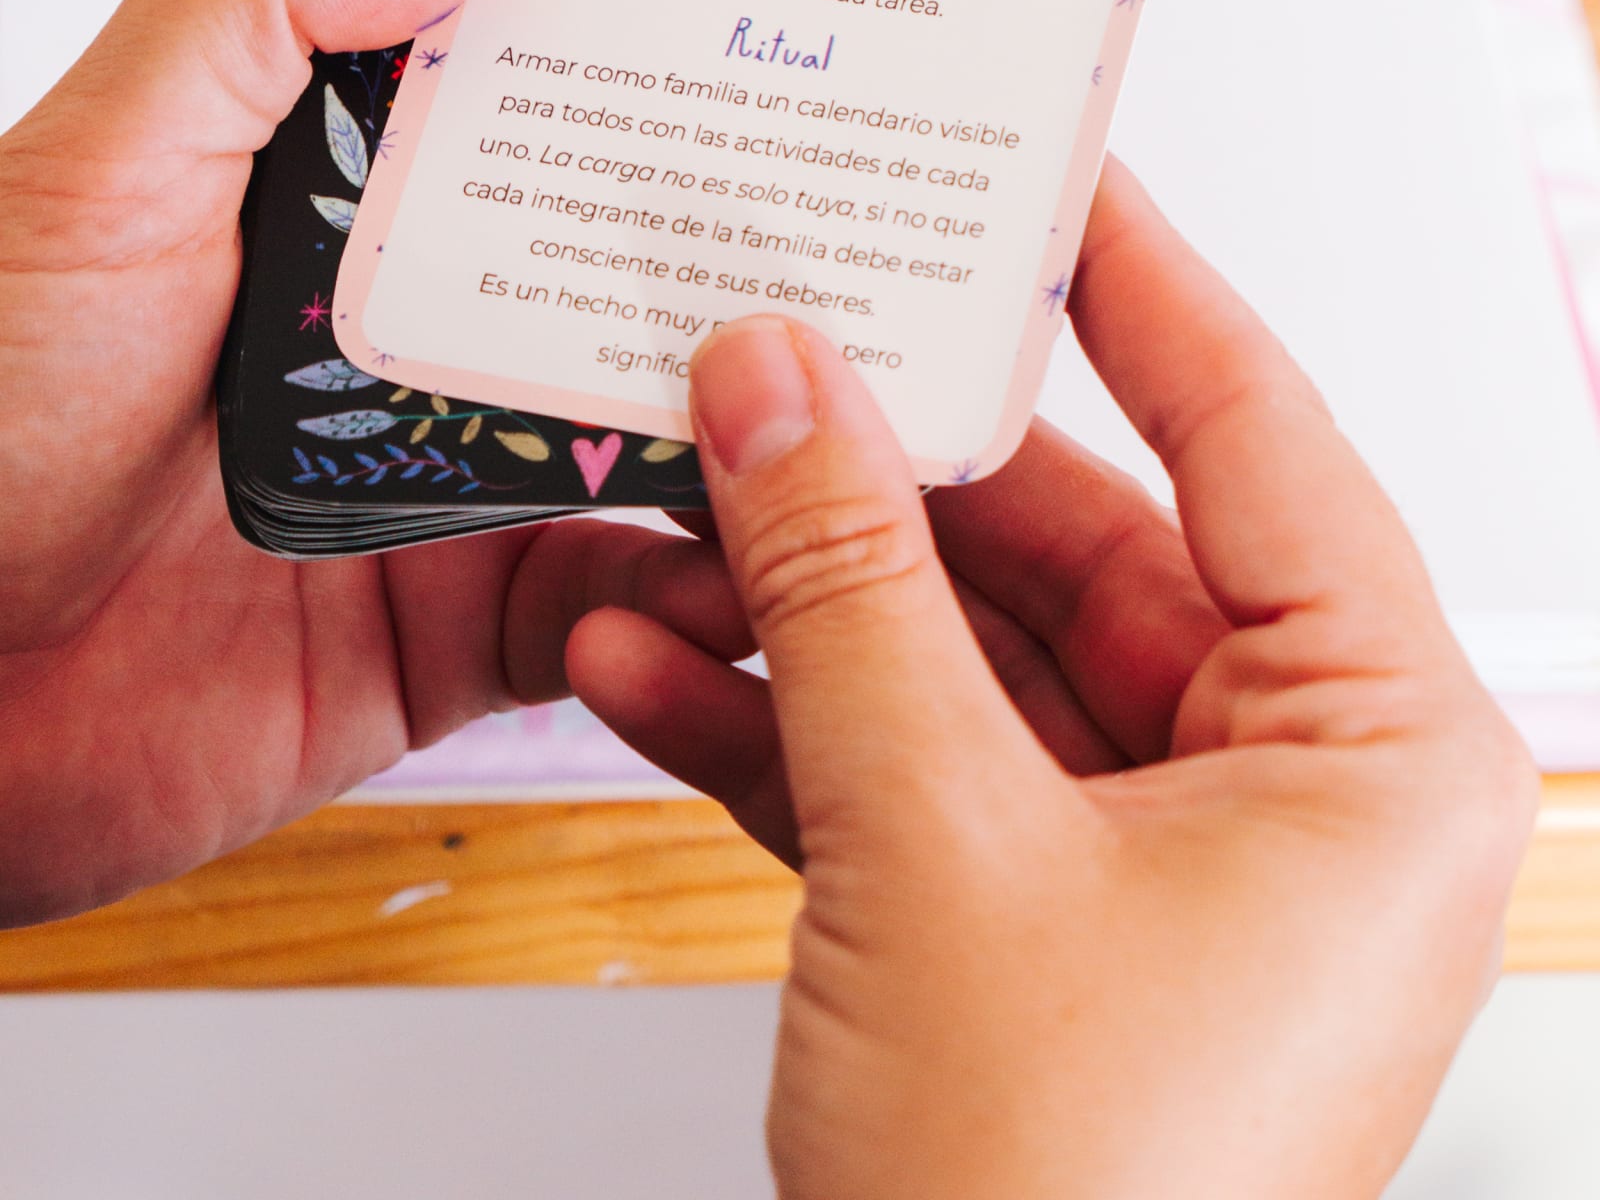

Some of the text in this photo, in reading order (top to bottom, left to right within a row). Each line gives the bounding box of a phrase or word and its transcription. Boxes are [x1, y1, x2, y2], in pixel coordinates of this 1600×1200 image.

[724, 16, 835, 72] Ritual
[495, 46, 1020, 149] Armar como familia un calendario visible
[497, 95, 990, 192] para todos con las actividades de cada
[462, 181, 974, 283] cada integrante de la familia debe estar
[479, 137, 985, 239] uno. La carga no es solo tuya, si no que
[479, 272, 509, 297] Es
[515, 283, 549, 304] un
[556, 286, 638, 320] hecho
[644, 307, 706, 337] muy
[842, 343, 903, 370] pero
[529, 239, 876, 316] consciente de sus deberes.
[596, 343, 690, 379] signific
